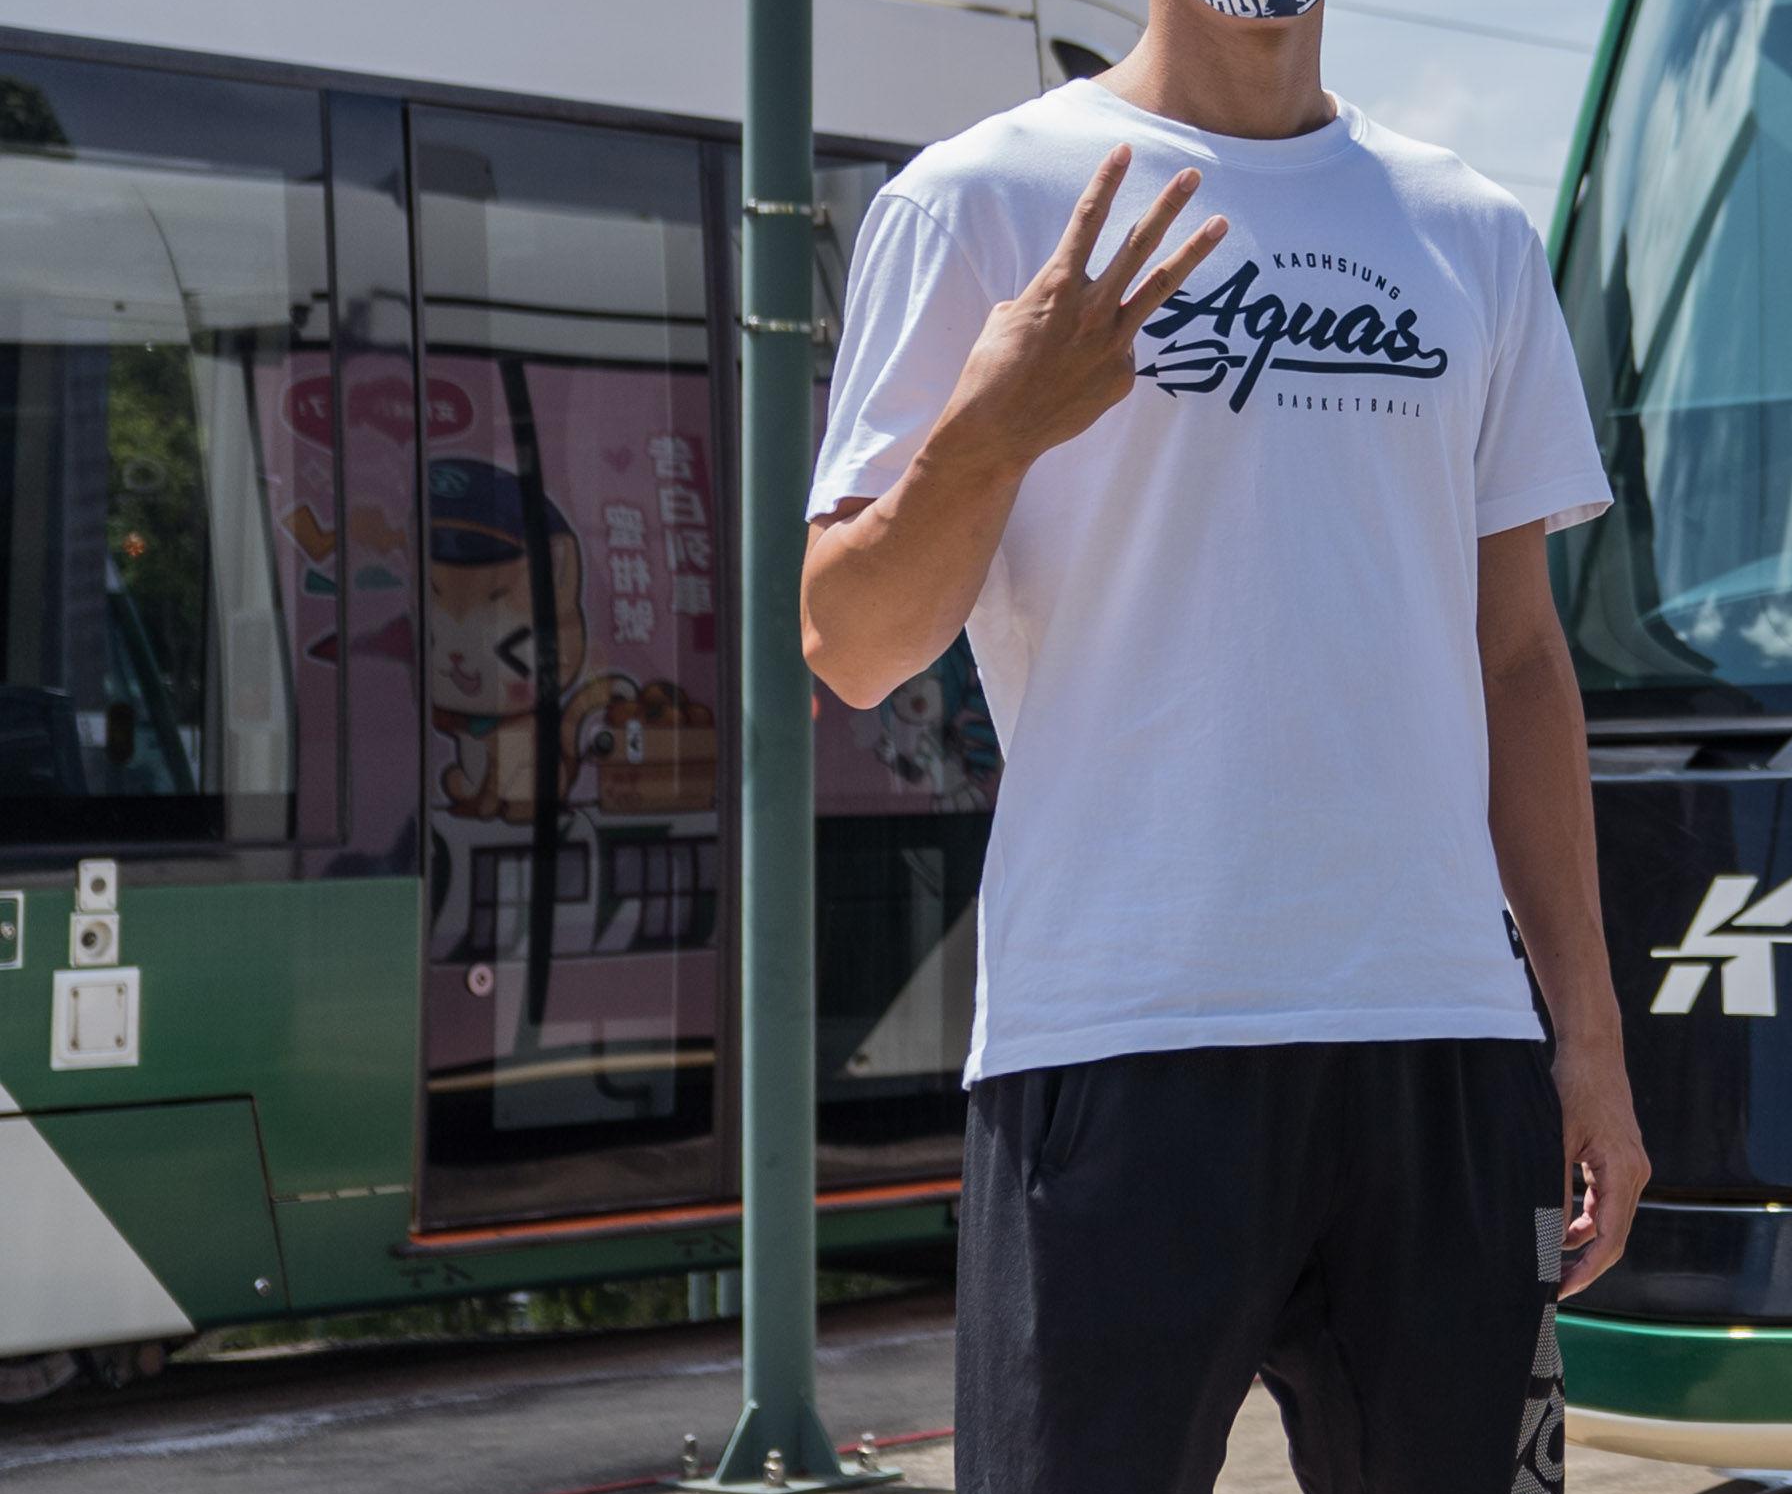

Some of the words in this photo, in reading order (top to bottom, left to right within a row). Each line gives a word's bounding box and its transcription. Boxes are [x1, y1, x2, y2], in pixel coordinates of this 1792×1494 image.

[1272, 252, 1401, 300] KAOHSIUNG
[1141, 260, 1448, 414] Aquas
[1277, 393, 1421, 418] BASKETBALL
